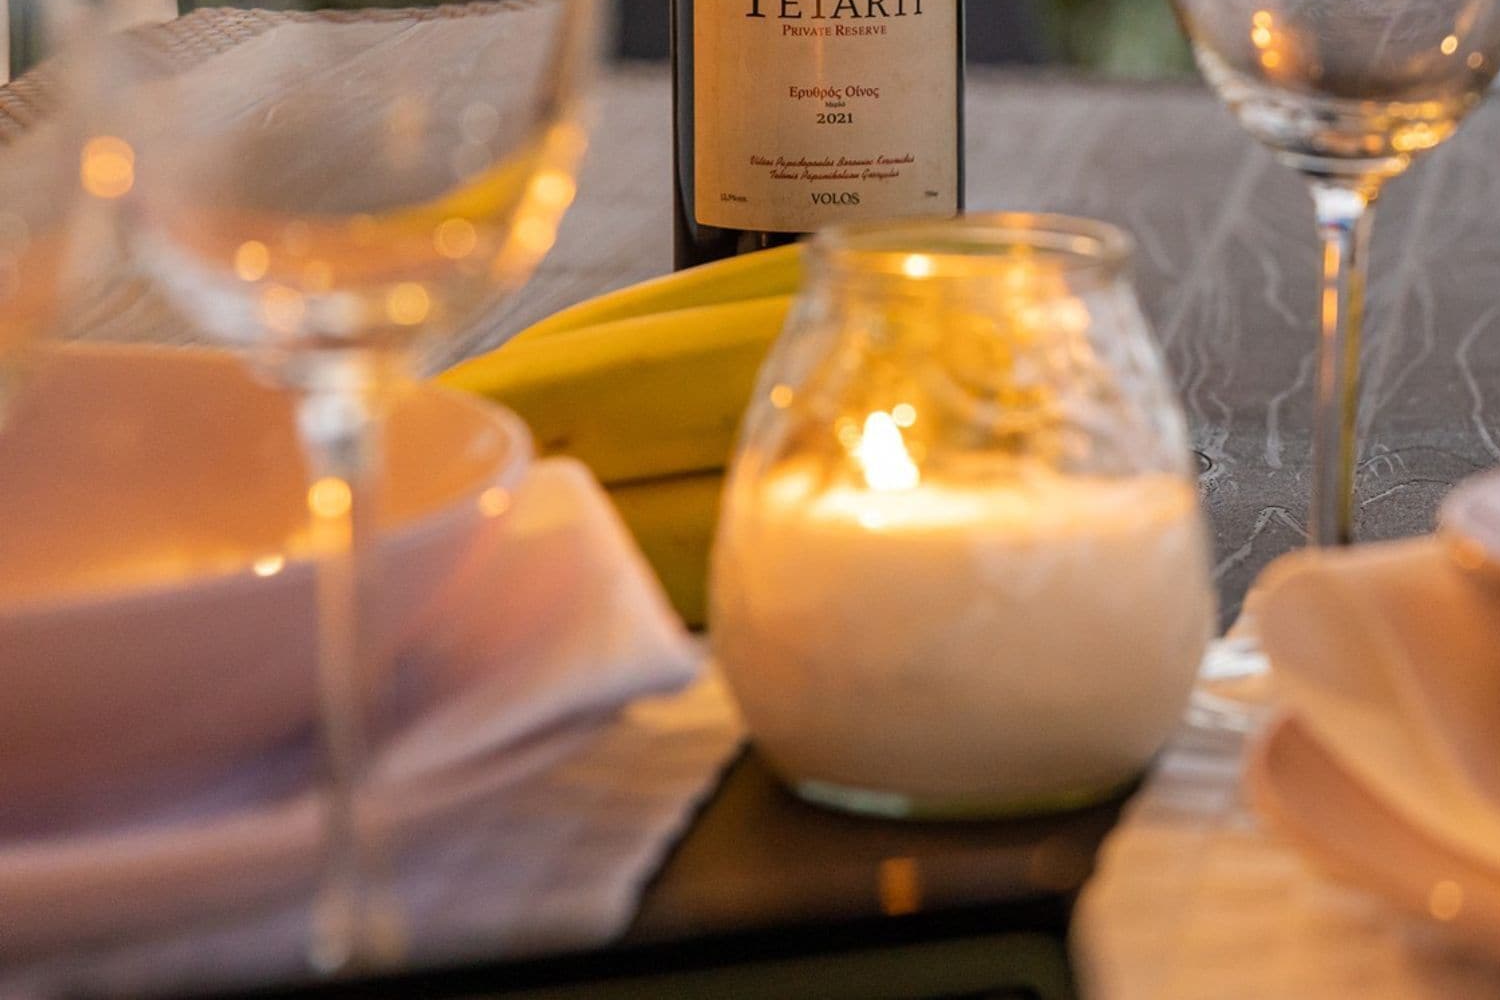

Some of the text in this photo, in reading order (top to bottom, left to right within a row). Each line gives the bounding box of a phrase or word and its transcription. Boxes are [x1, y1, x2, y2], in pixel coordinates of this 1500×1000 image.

[782, 24, 887, 36] PRIVATE RESERVE
[789, 85, 880, 100] Ερυθρός Οίνος
[816, 112, 853, 124] 2021
[811, 192, 860, 205] VOLOS
